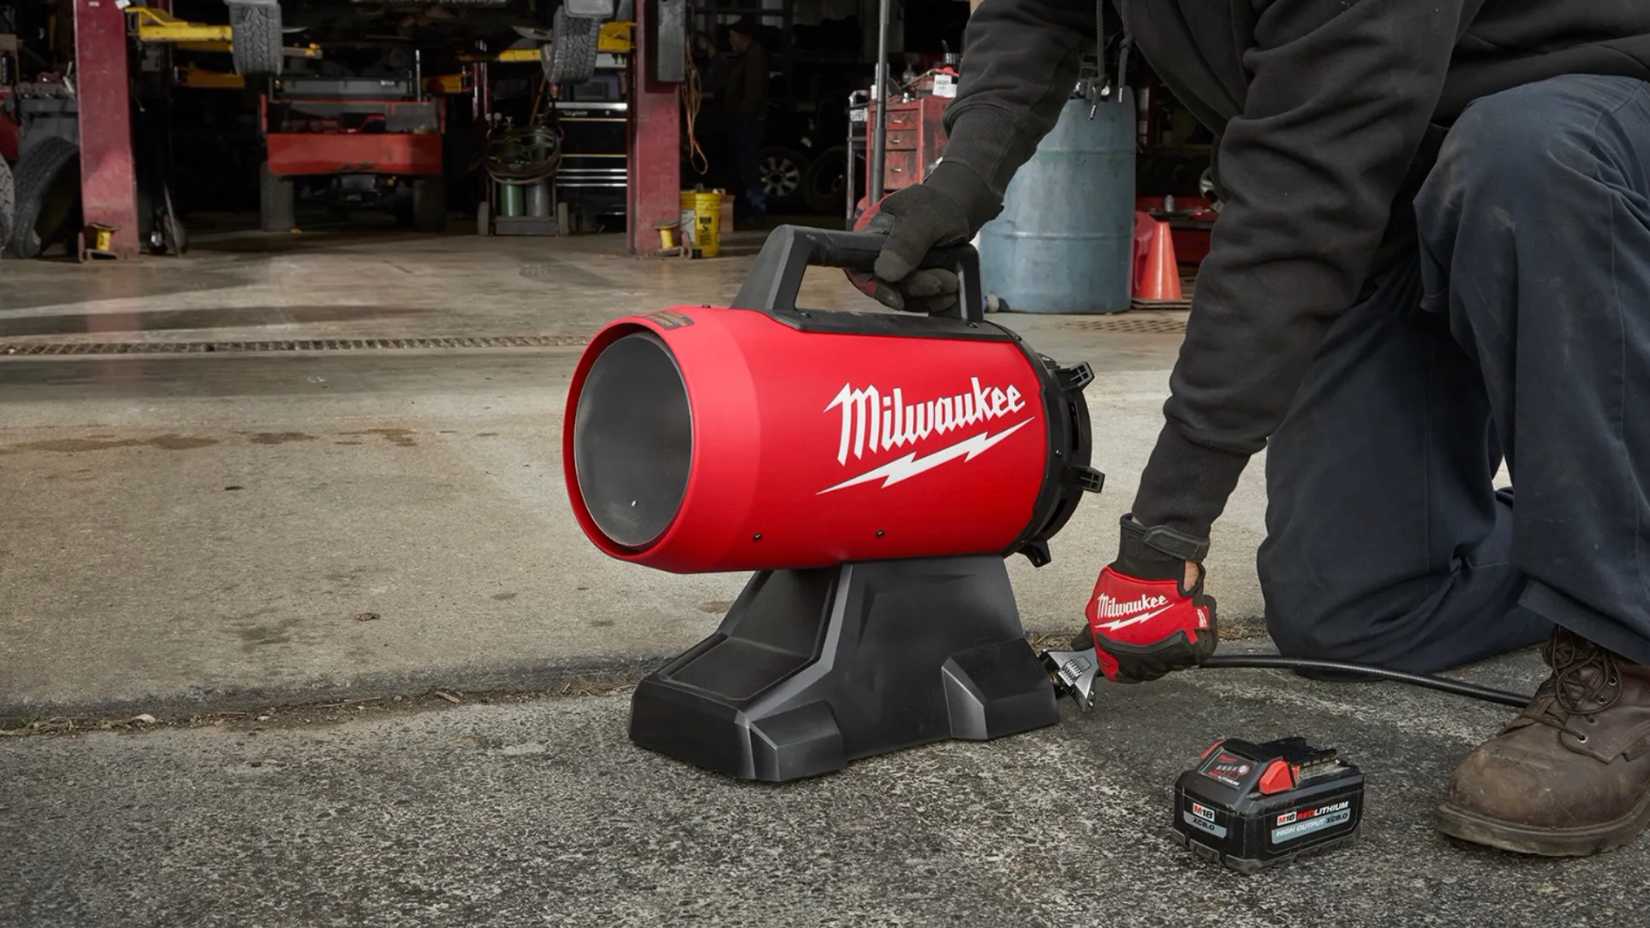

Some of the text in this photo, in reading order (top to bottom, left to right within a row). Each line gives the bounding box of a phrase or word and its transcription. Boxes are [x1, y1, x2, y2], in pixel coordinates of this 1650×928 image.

[823, 377, 1026, 466] Milwaukee
[1096, 592, 1169, 619] Milwaukee
[1193, 804, 1214, 820] M18
[1279, 813, 1295, 825] M18
